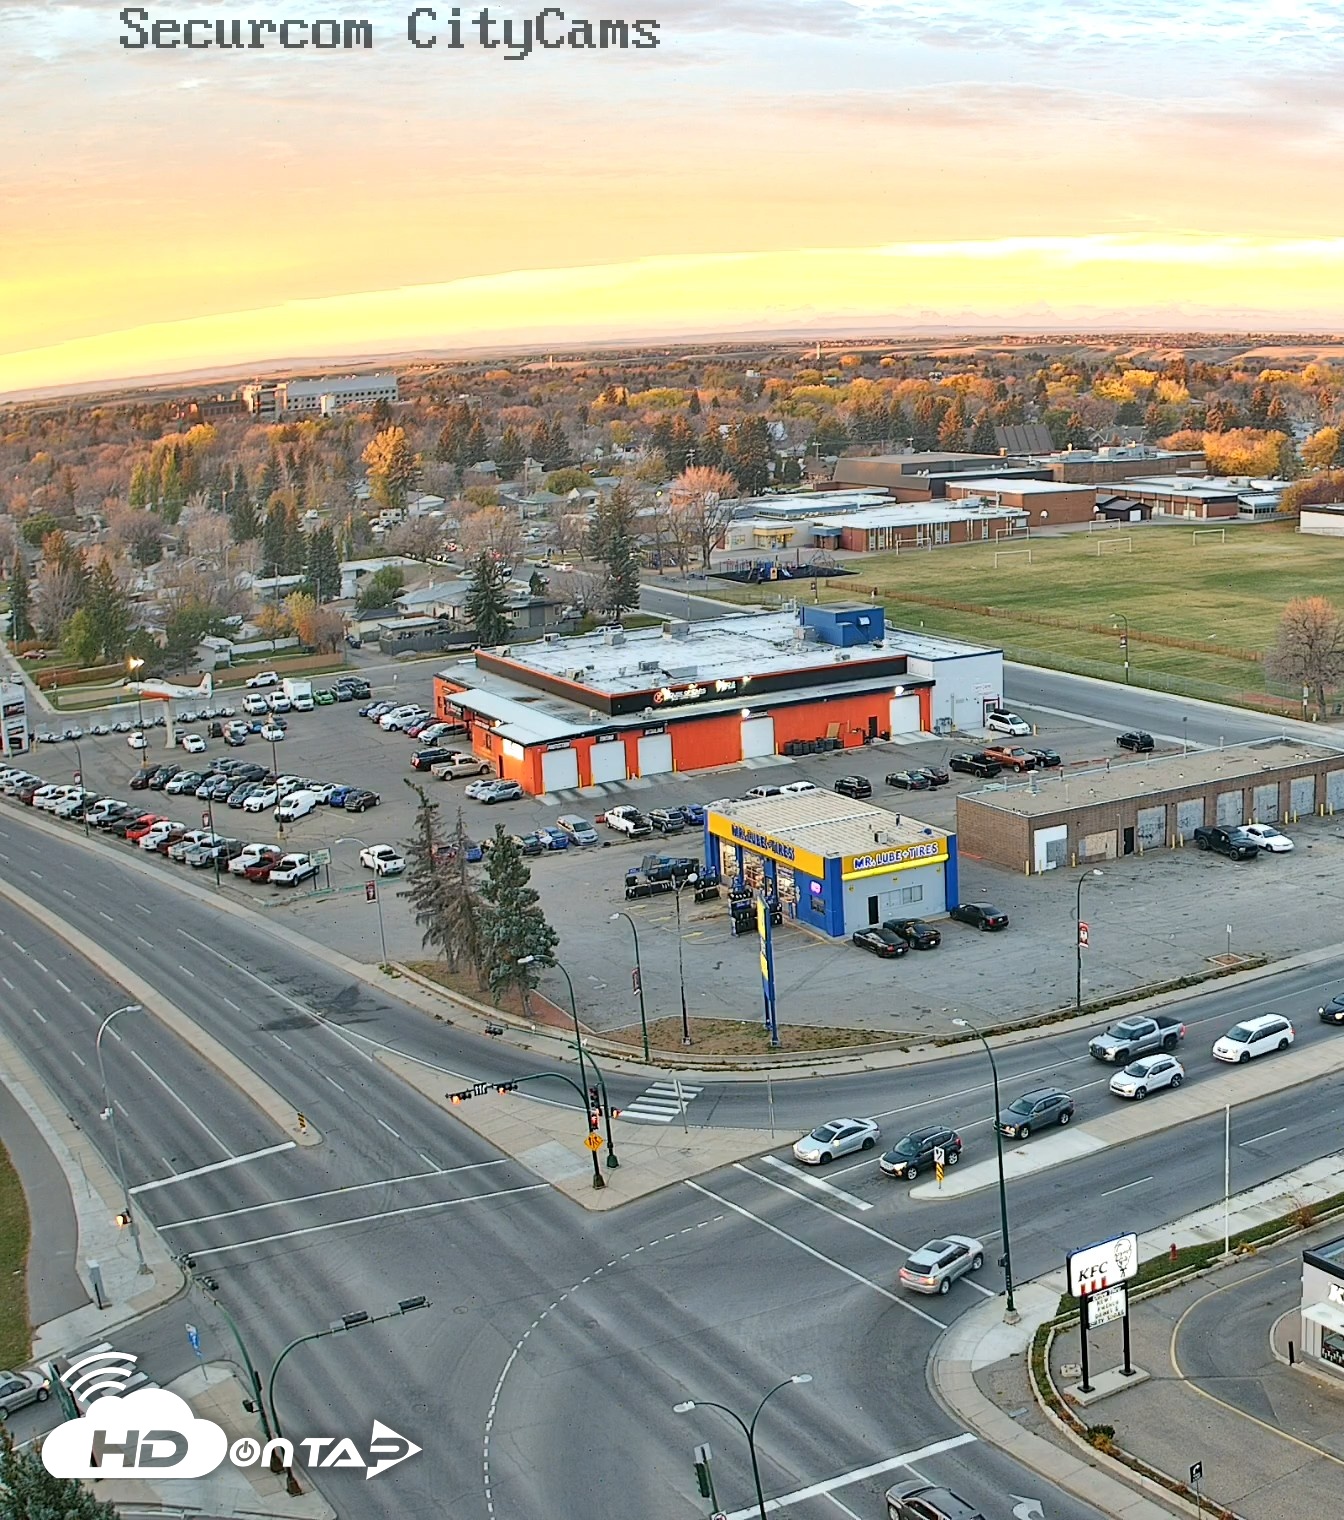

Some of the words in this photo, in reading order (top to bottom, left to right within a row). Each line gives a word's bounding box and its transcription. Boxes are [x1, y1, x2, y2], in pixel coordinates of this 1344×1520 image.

[853, 856, 876, 870] MR.
[876, 850, 902, 866] LUBE
[909, 842, 939, 859] TIRES
[1078, 1261, 1108, 1282] KFC
